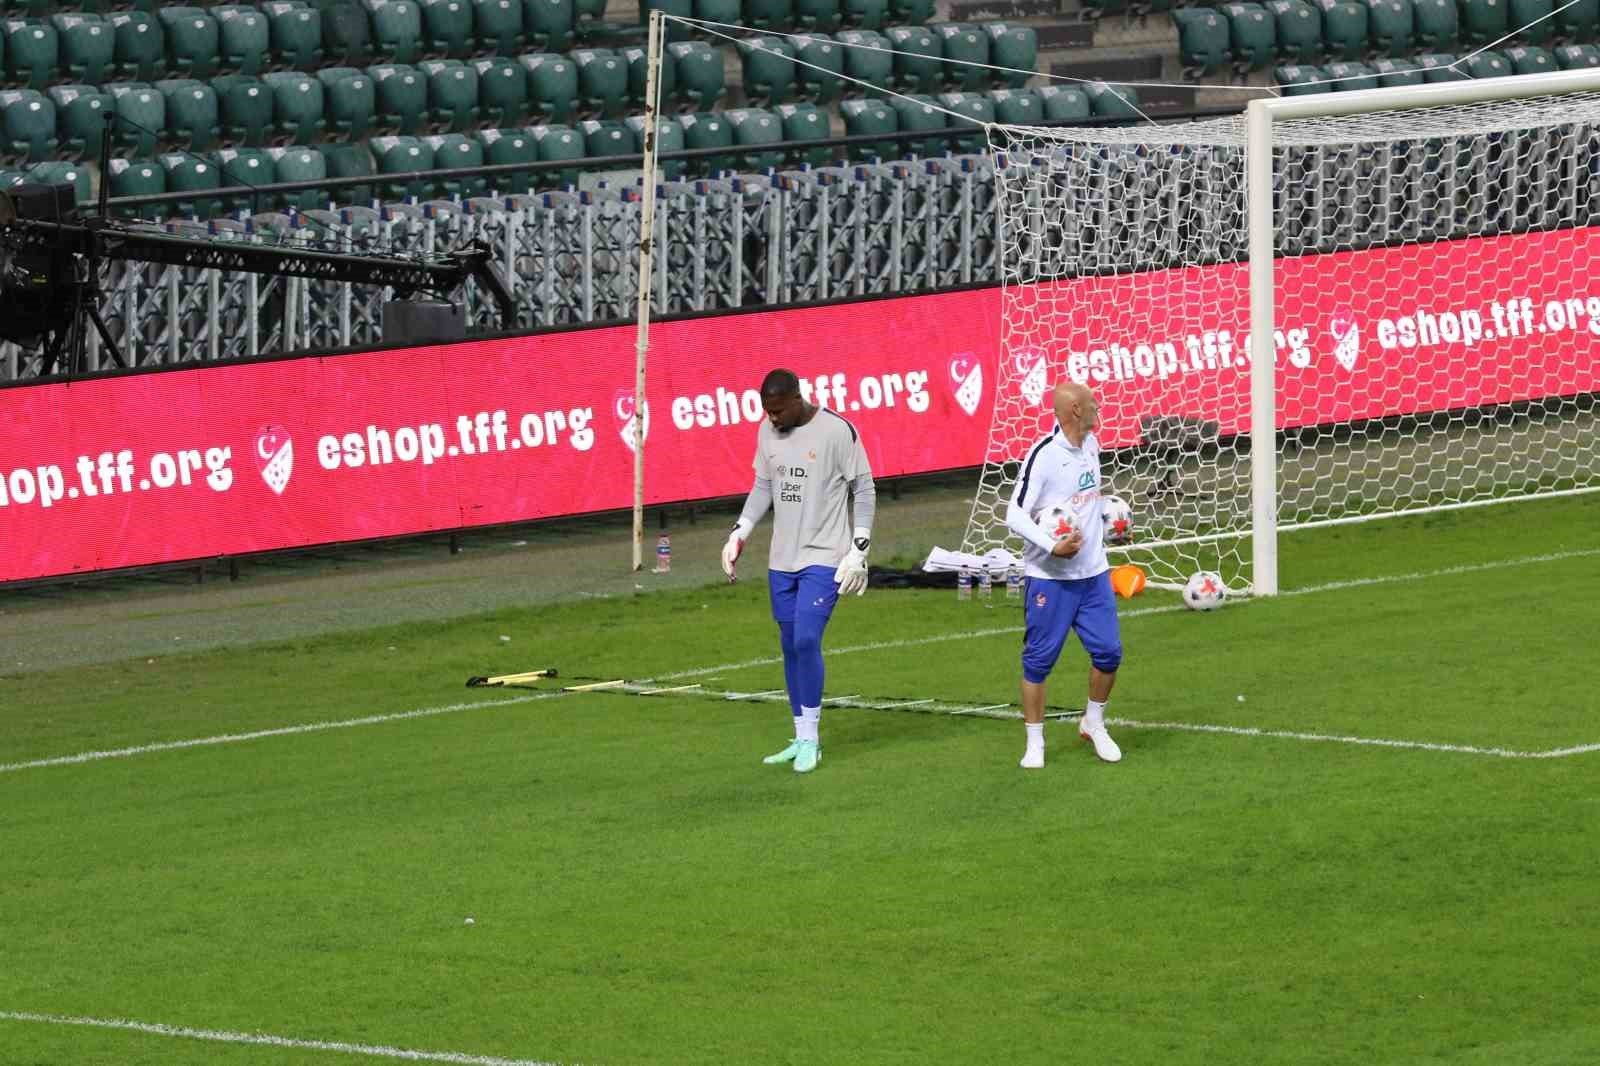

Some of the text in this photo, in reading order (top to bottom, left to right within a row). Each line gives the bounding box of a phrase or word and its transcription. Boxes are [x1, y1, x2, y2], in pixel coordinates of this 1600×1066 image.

[1377, 296, 1600, 349] eshop.tff.org
[1067, 327, 1311, 385] eshop.tff.rg
[671, 370, 930, 430] eshotff.org
[317, 407, 595, 469] eshop.tff.org
[781, 492, 802, 503] Eats
